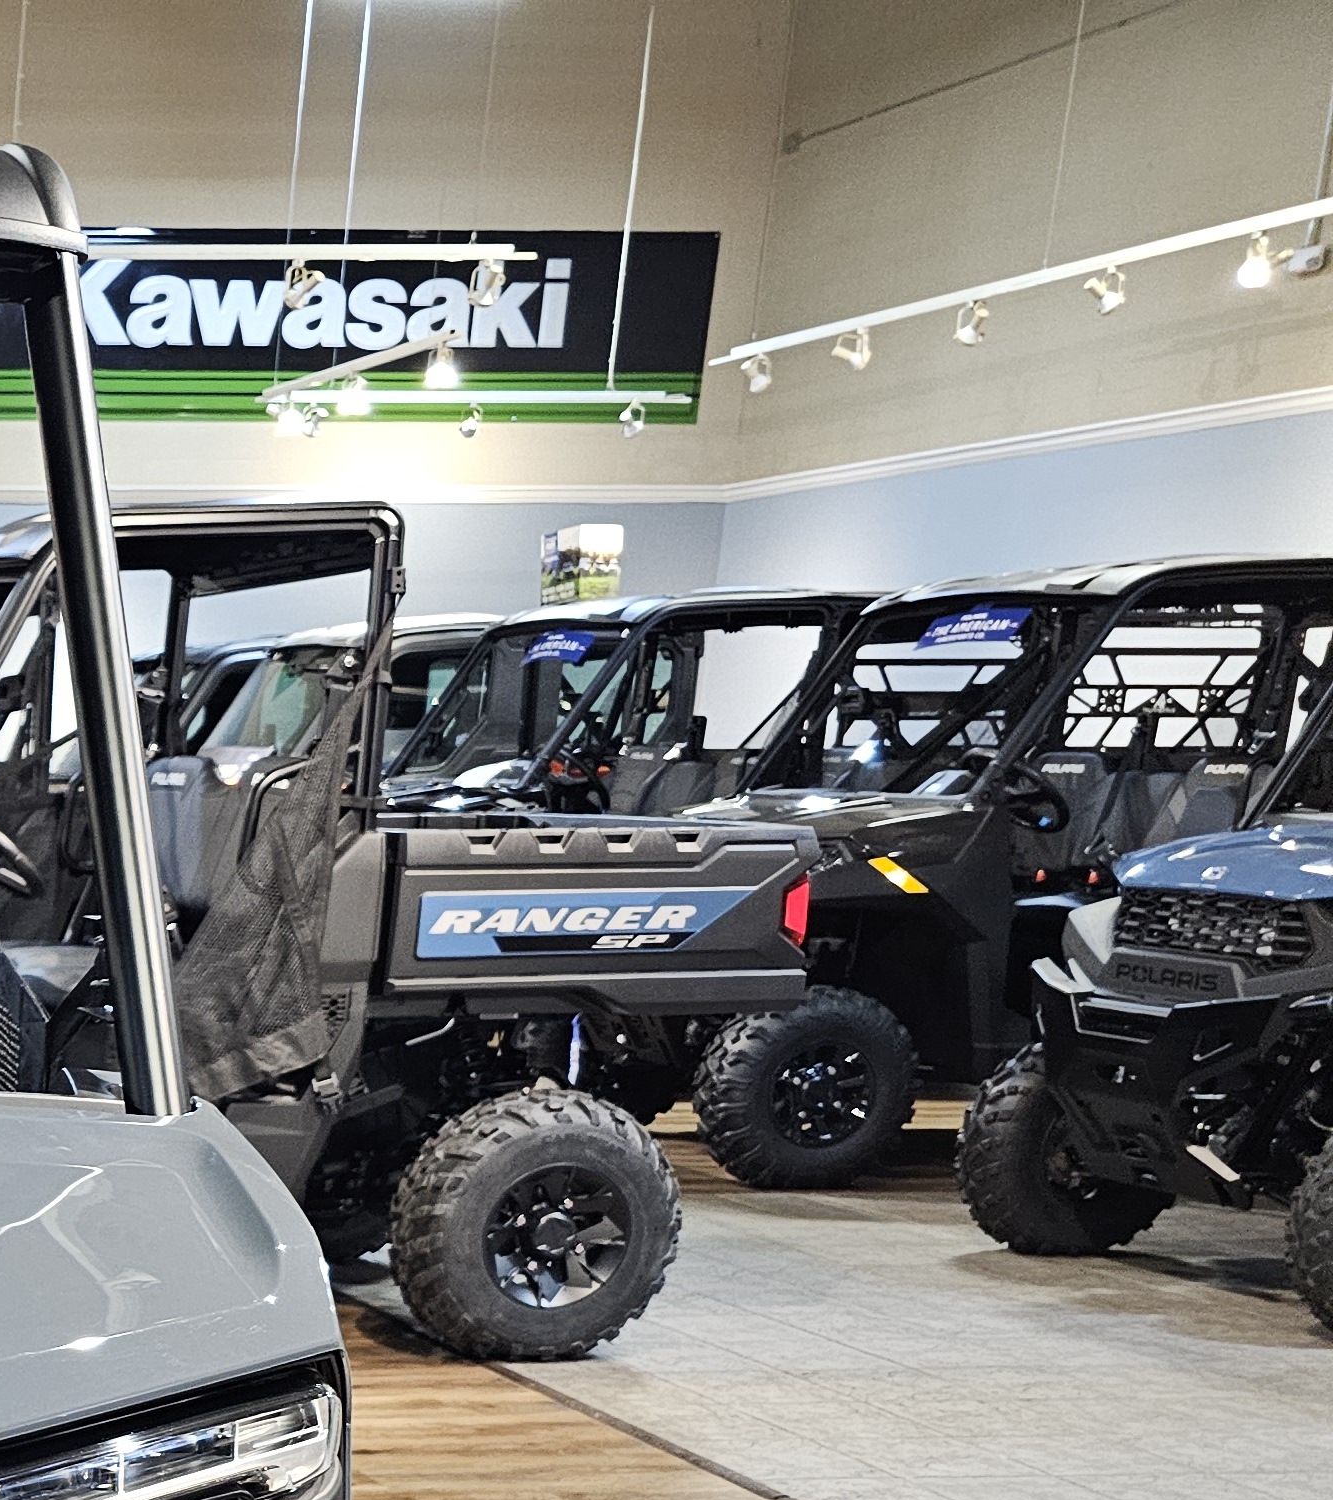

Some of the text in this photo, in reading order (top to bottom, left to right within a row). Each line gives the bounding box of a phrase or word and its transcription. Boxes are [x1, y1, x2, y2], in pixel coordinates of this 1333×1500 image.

[80, 257, 572, 350] Kawasaki
[428, 904, 698, 935] RANGER
[590, 934, 670, 950] SP
[1116, 963, 1218, 993] POLARIS
